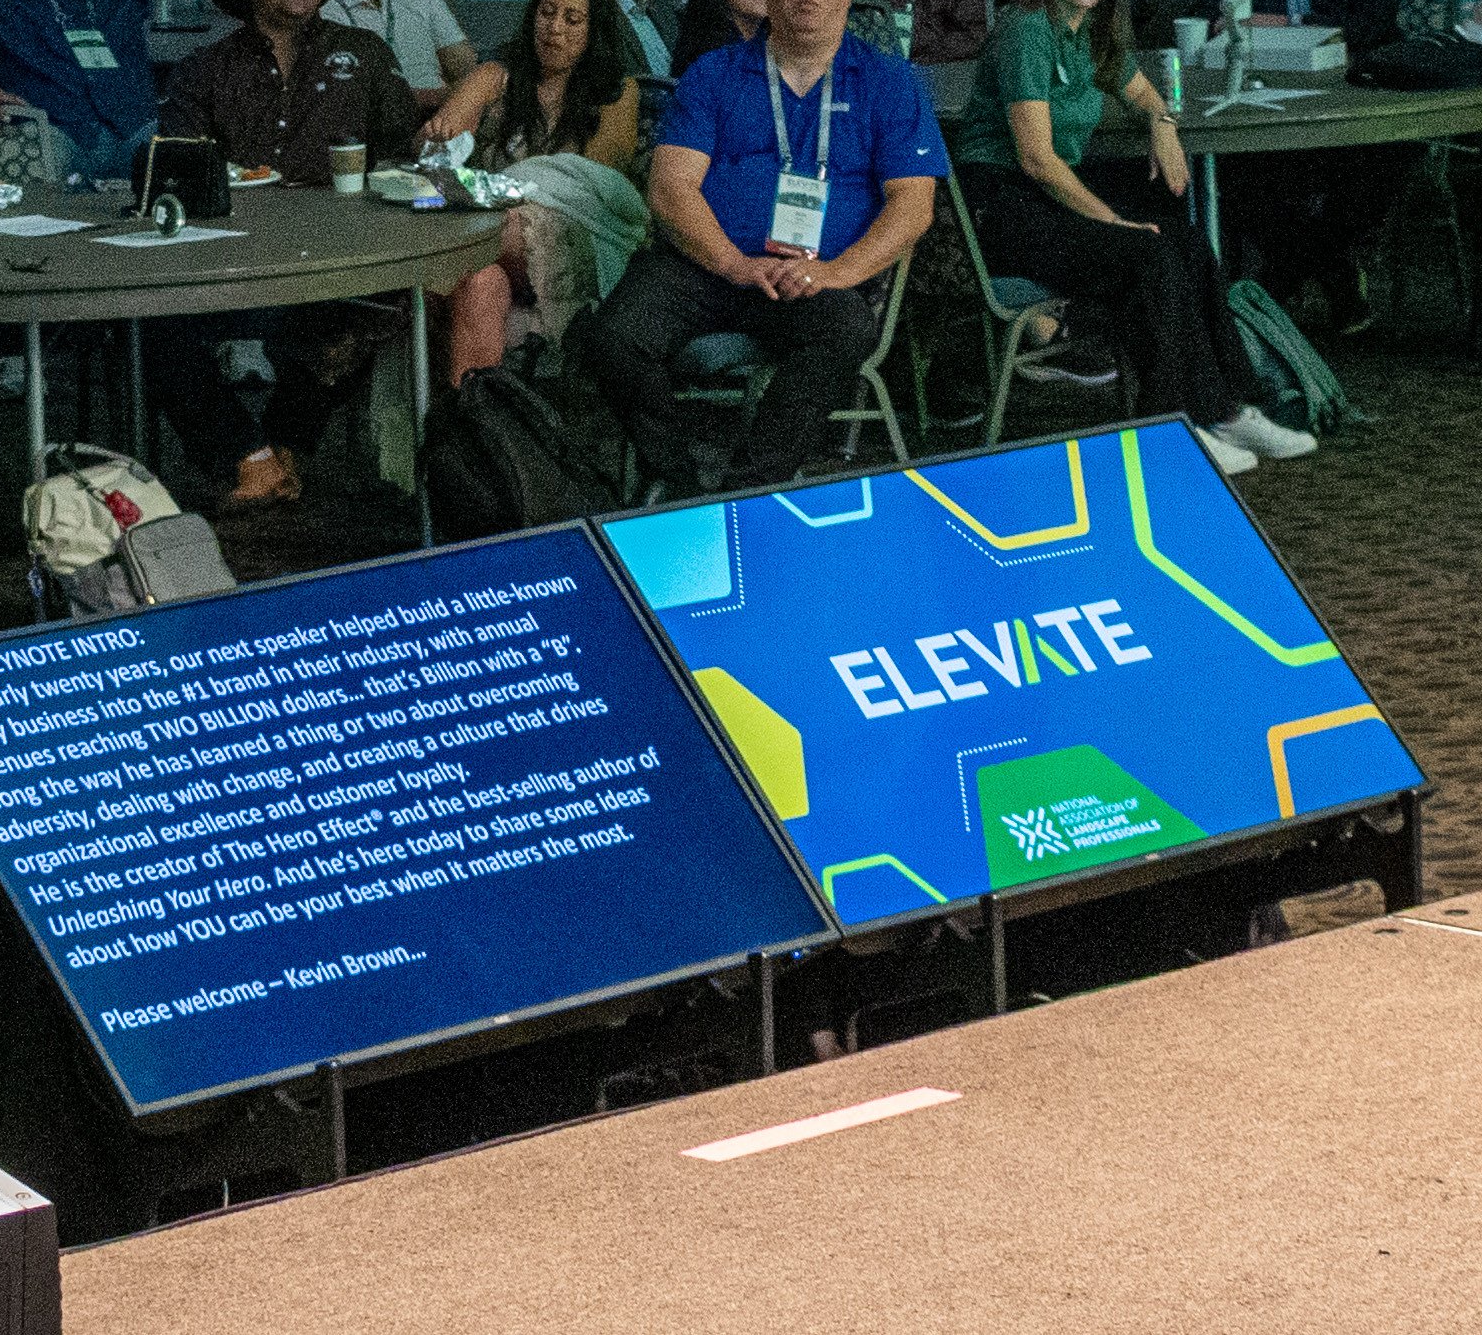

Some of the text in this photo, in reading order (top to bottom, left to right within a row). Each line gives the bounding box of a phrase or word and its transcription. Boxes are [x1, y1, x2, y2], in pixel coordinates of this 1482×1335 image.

[5, 704, 100, 737] business
[96, 696, 143, 719] into
[141, 687, 182, 710] the
[179, 679, 211, 702] #1
[207, 665, 272, 696] brand
[268, 663, 295, 684] in
[292, 653, 342, 679] their
[340, 638, 430, 669] industry,
[426, 625, 474, 651] with
[472, 610, 540, 642] annual
[29, 670, 105, 699] twenty
[103, 658, 169, 688] years,
[167, 649, 204, 672] our
[205, 638, 255, 664] next
[252, 624, 329, 657] speaker
[327, 606, 400, 639] helped
[395, 596, 451, 625] build
[449, 598, 466, 615] a
[461, 575, 578, 611] little-known
[69, 626, 146, 657] INTRO:
[829, 598, 1153, 719] ELEVATE
[38, 776, 80, 799] the
[77, 767, 123, 791] way
[120, 760, 154, 782] he
[150, 752, 194, 775] has
[189, 732, 272, 767] learned
[271, 733, 289, 750] a
[285, 721, 345, 747] thing
[341, 716, 365, 736] or
[364, 707, 408, 730] two
[407, 692, 469, 721] about
[466, 670, 581, 708] overcoming
[55, 729, 149, 762] reaching
[142, 714, 200, 742] TWO
[197, 697, 281, 732] BILLION
[418, 658, 483, 685] Billion
[480, 646, 528, 672] with
[526, 646, 543, 663] a
[95, 791, 176, 822] dealing
[171, 777, 222, 805] with
[221, 765, 303, 795] change,
[300, 750, 343, 778] and
[341, 737, 426, 769] creating
[421, 734, 439, 752] a
[438, 719, 509, 748] culture
[505, 707, 551, 733] that
[549, 696, 609, 723] drives
[12, 761, 471, 874] organizational excellence and customer loyalty.
[27, 883, 64, 906] He
[60, 877, 85, 898] is
[82, 870, 124, 894] the
[123, 853, 198, 886] creator
[199, 843, 224, 869] of
[221, 839, 267, 862] The
[263, 828, 319, 854] Hero
[387, 798, 430, 827] and
[426, 794, 466, 817] the
[461, 770, 577, 809] best-selling
[572, 755, 637, 785] author
[637, 744, 661, 770] of
[46, 896, 166, 937] Unleashing
[163, 884, 211, 910] Your
[213, 873, 272, 900] Hero.
[272, 857, 317, 887] And
[355, 842, 408, 867] here
[405, 828, 465, 856] today
[463, 823, 490, 843] to
[488, 810, 545, 837] share
[543, 798, 599, 825] some
[594, 785, 651, 812] ideas
[1050, 794, 1102, 814] NATIONAL
[1058, 797, 1140, 826] ASSOCIATION OF
[1064, 814, 1131, 838] LANDSCAPE
[1072, 819, 1162, 849] PROFESSIONALS
[65, 822, 635, 969] about how YOU can be your best when it matters the most.
[99, 1001, 174, 1033] Please
[171, 979, 268, 1016] welcome
[282, 959, 344, 989] Kevin
